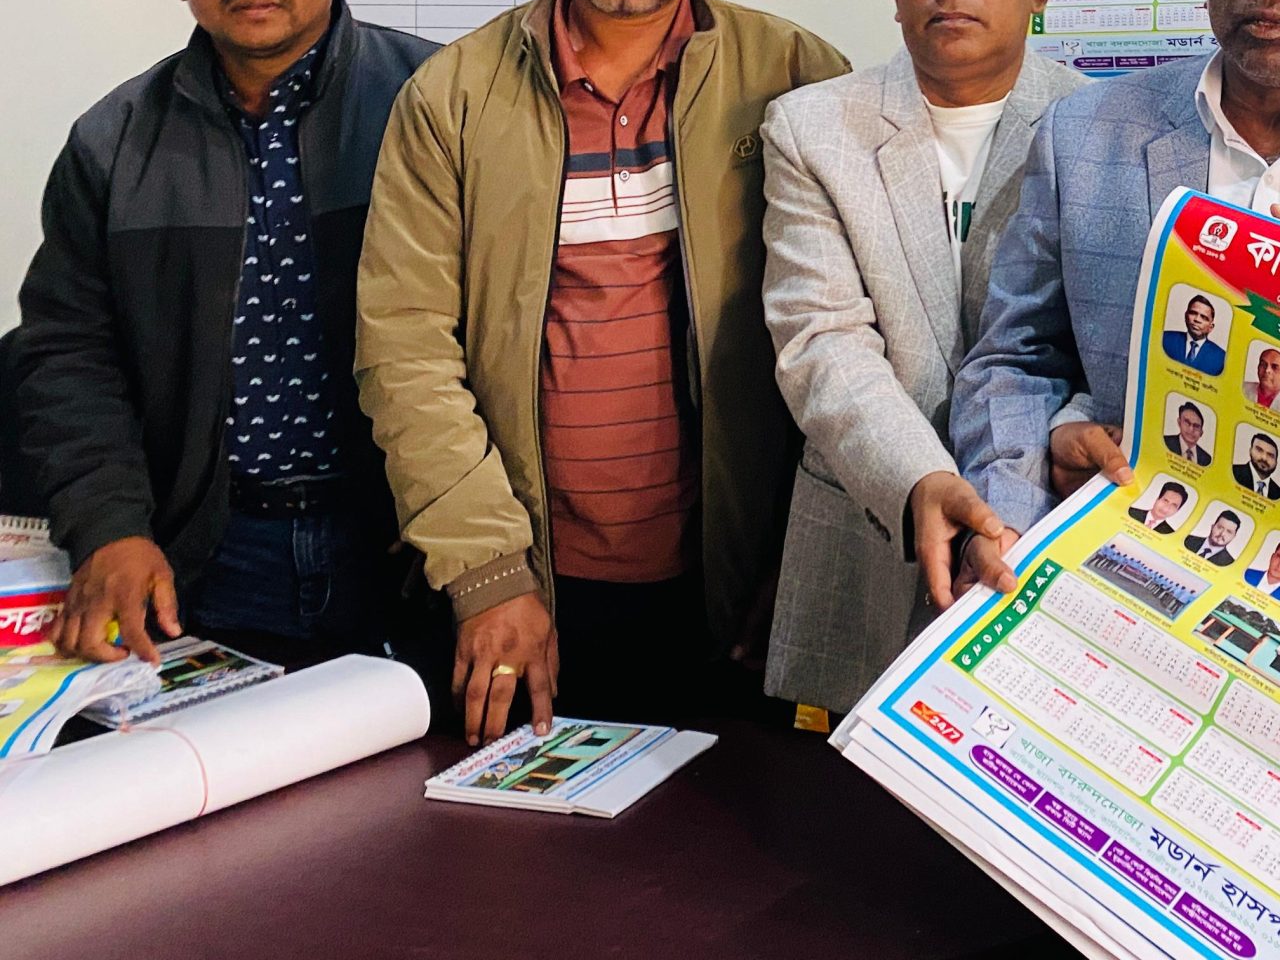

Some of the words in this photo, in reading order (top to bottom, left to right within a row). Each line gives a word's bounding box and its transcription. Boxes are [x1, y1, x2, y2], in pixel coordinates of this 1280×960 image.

[1166, 35, 1204, 47] মডার্ন
[928, 714, 961, 742] 24/7
[1150, 827, 1221, 882] মডার্ন
